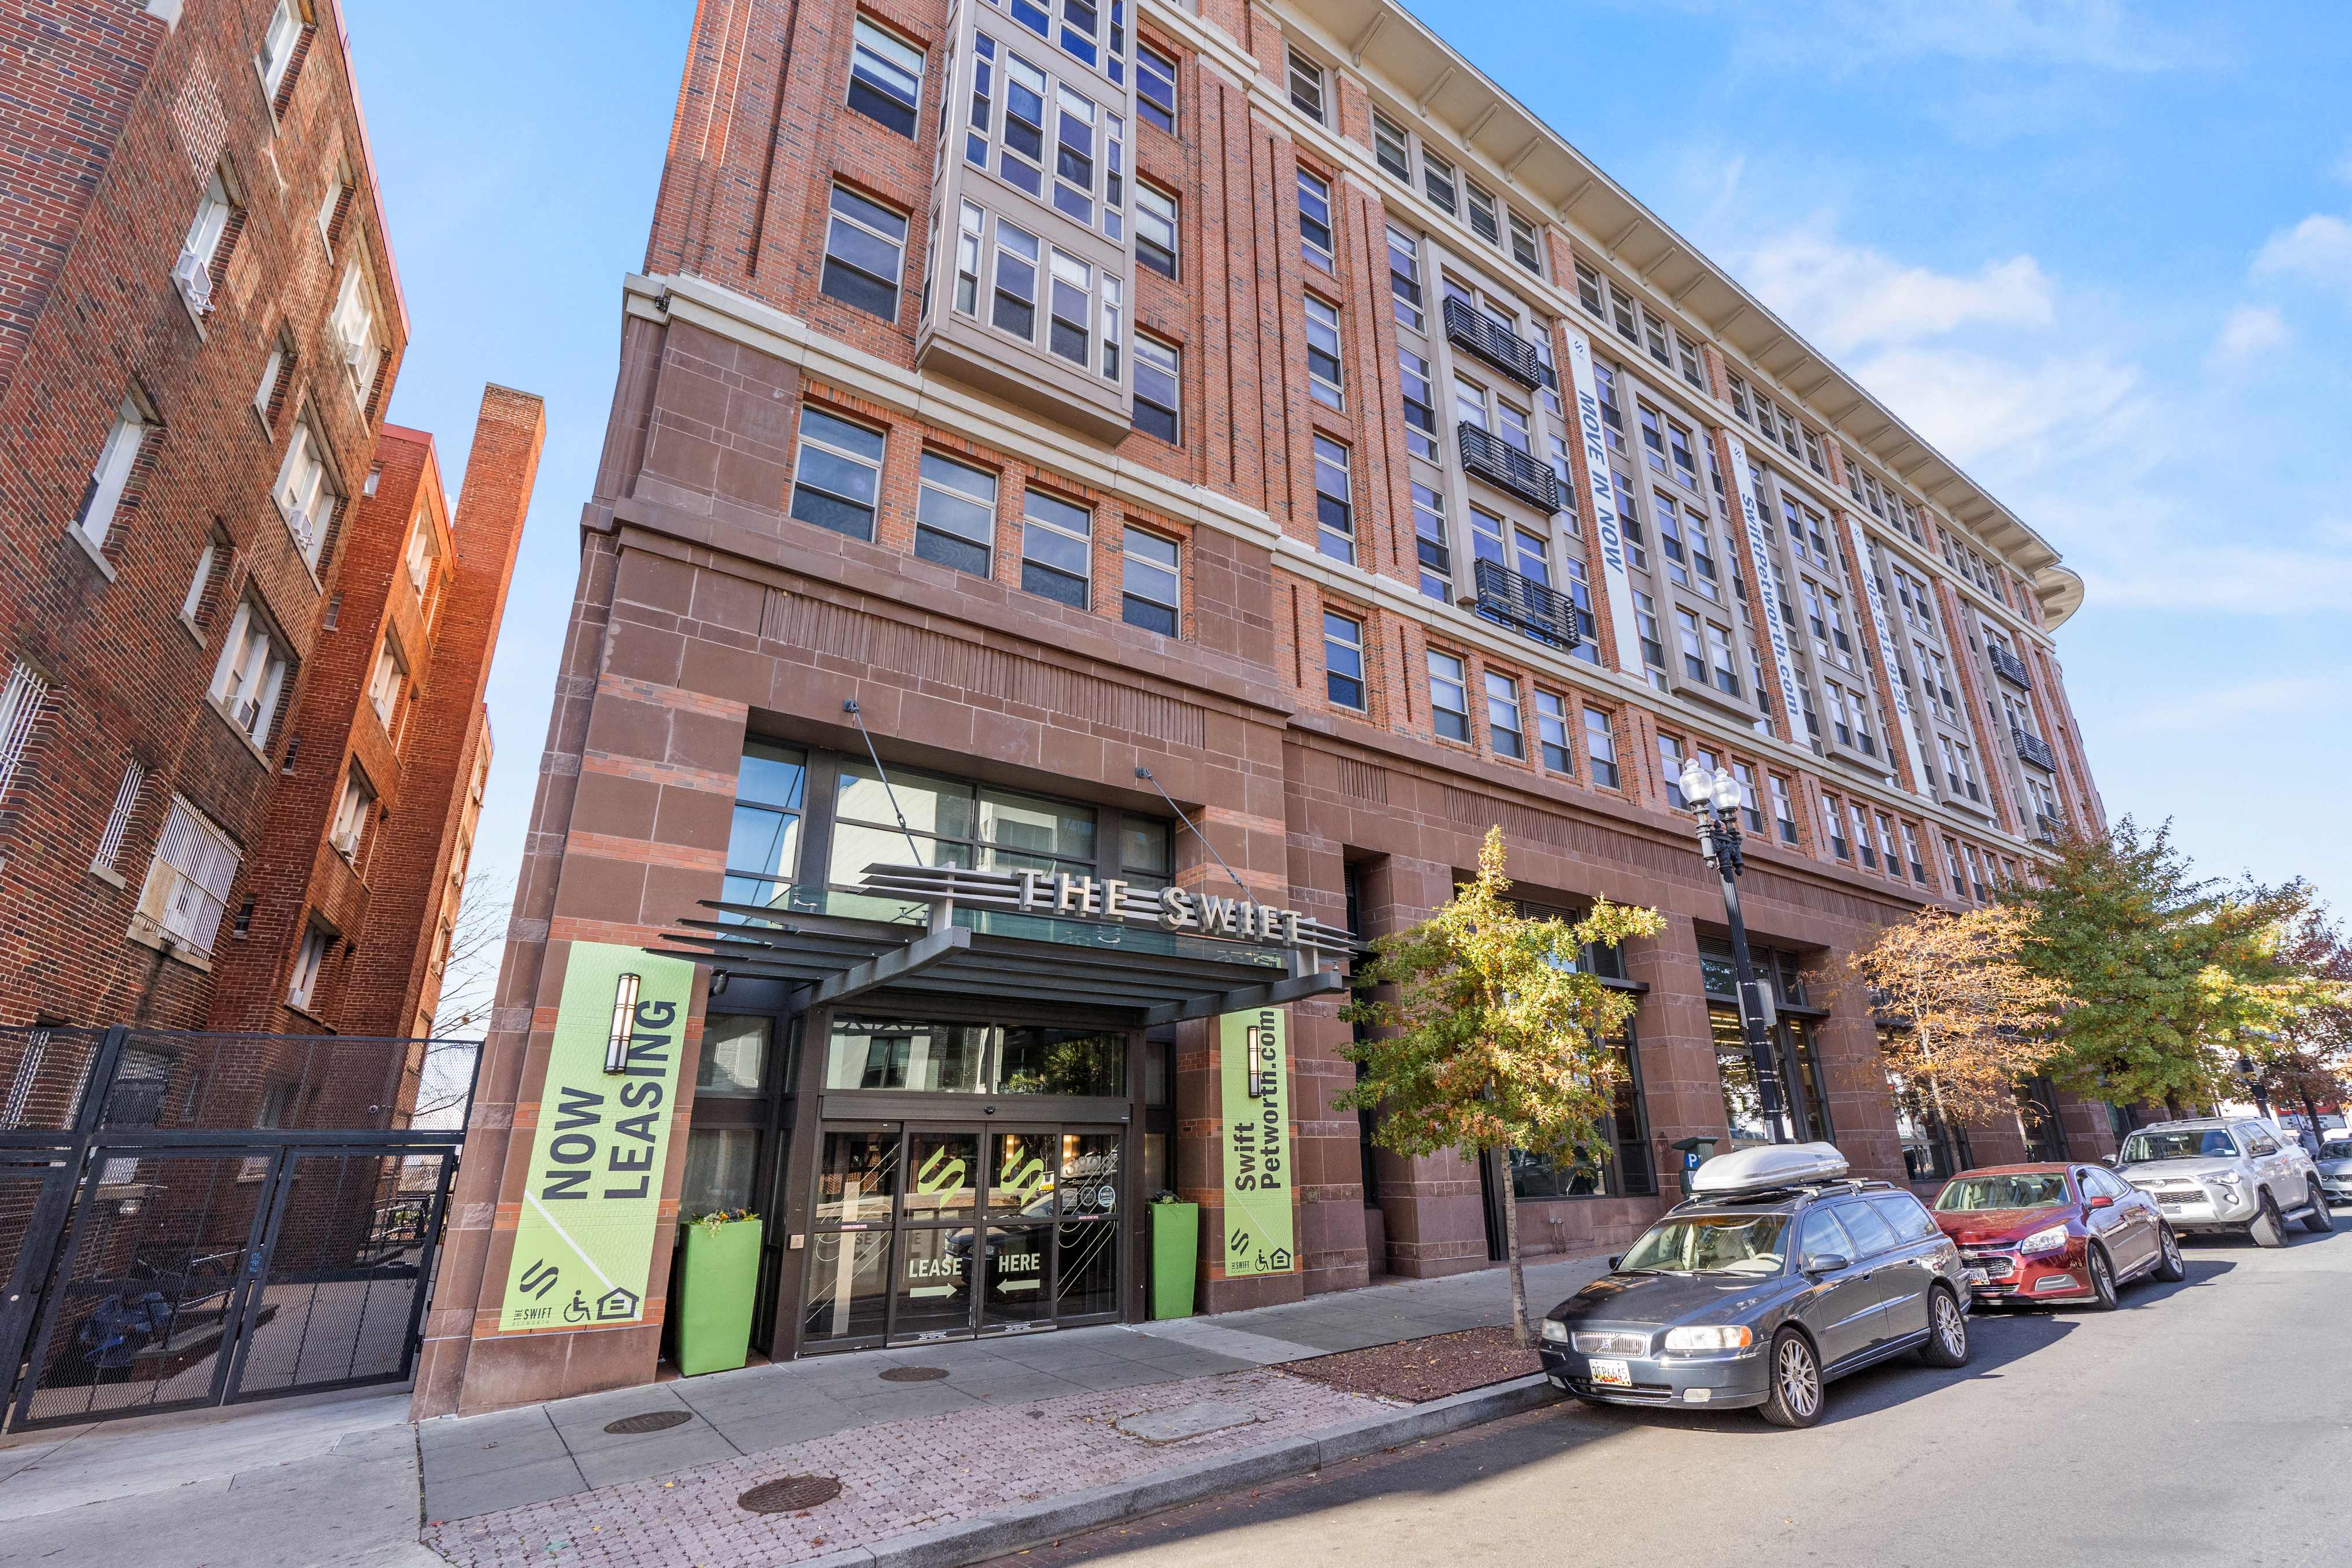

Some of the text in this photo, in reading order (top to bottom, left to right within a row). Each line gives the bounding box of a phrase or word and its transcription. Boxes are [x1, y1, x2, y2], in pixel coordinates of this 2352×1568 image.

[1579, 390, 1624, 574] MOVE IN NOW
[1742, 493, 1799, 716] SwiftPetworth.com
[1862, 568, 1908, 716] 202.541.9120
[1015, 868, 1302, 947] THE SWIFT
[603, 1000, 677, 1199] LEASING
[1260, 1010, 1281, 1190] Petworth.com
[541, 1086, 605, 1200] NOW
[1065, 1155, 1112, 1176] 3828
[1234, 1122, 1257, 1192] Swift
[1688, 1153, 1697, 1167] P
[909, 1257, 963, 1278] LEASE
[998, 1252, 1040, 1273] HERE
[1236, 1261, 1249, 1270] SWIFT
[513, 1307, 553, 1321] THE SWIFT
